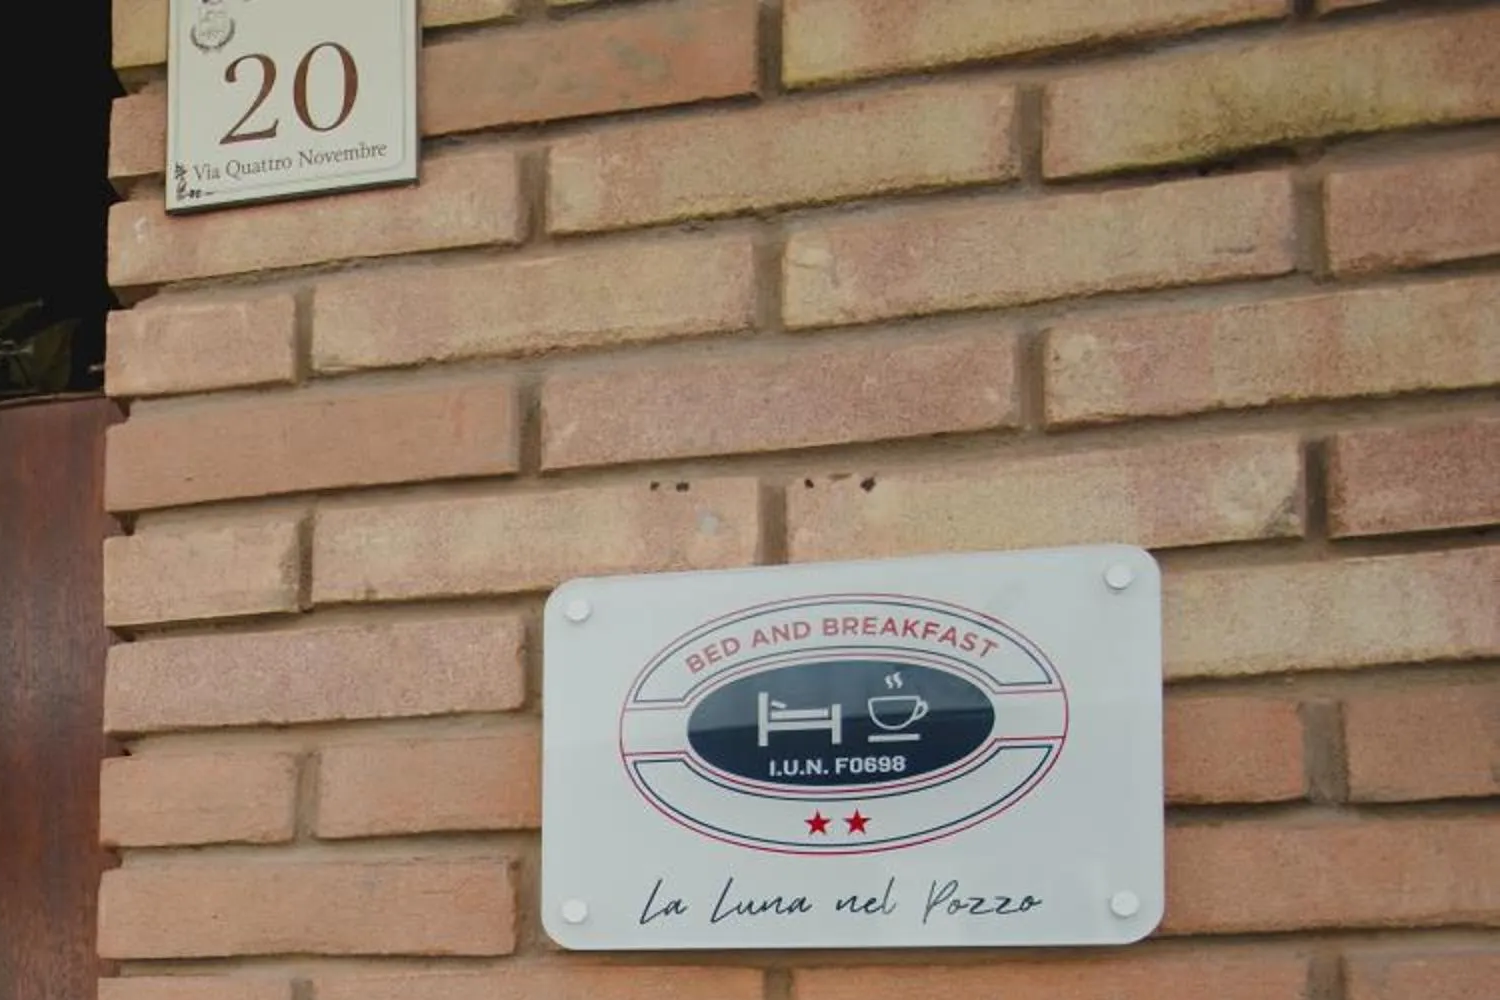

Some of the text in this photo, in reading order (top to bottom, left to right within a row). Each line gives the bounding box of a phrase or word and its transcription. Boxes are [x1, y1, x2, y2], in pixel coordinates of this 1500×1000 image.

[219, 41, 359, 145] 20
[193, 142, 388, 181] Via Quattro Novembre
[684, 616, 999, 674] BED AND BREAKFAST
[769, 755, 908, 777] I.U.N. F0698
[639, 877, 1043, 926] La Luna nel Pozzo
